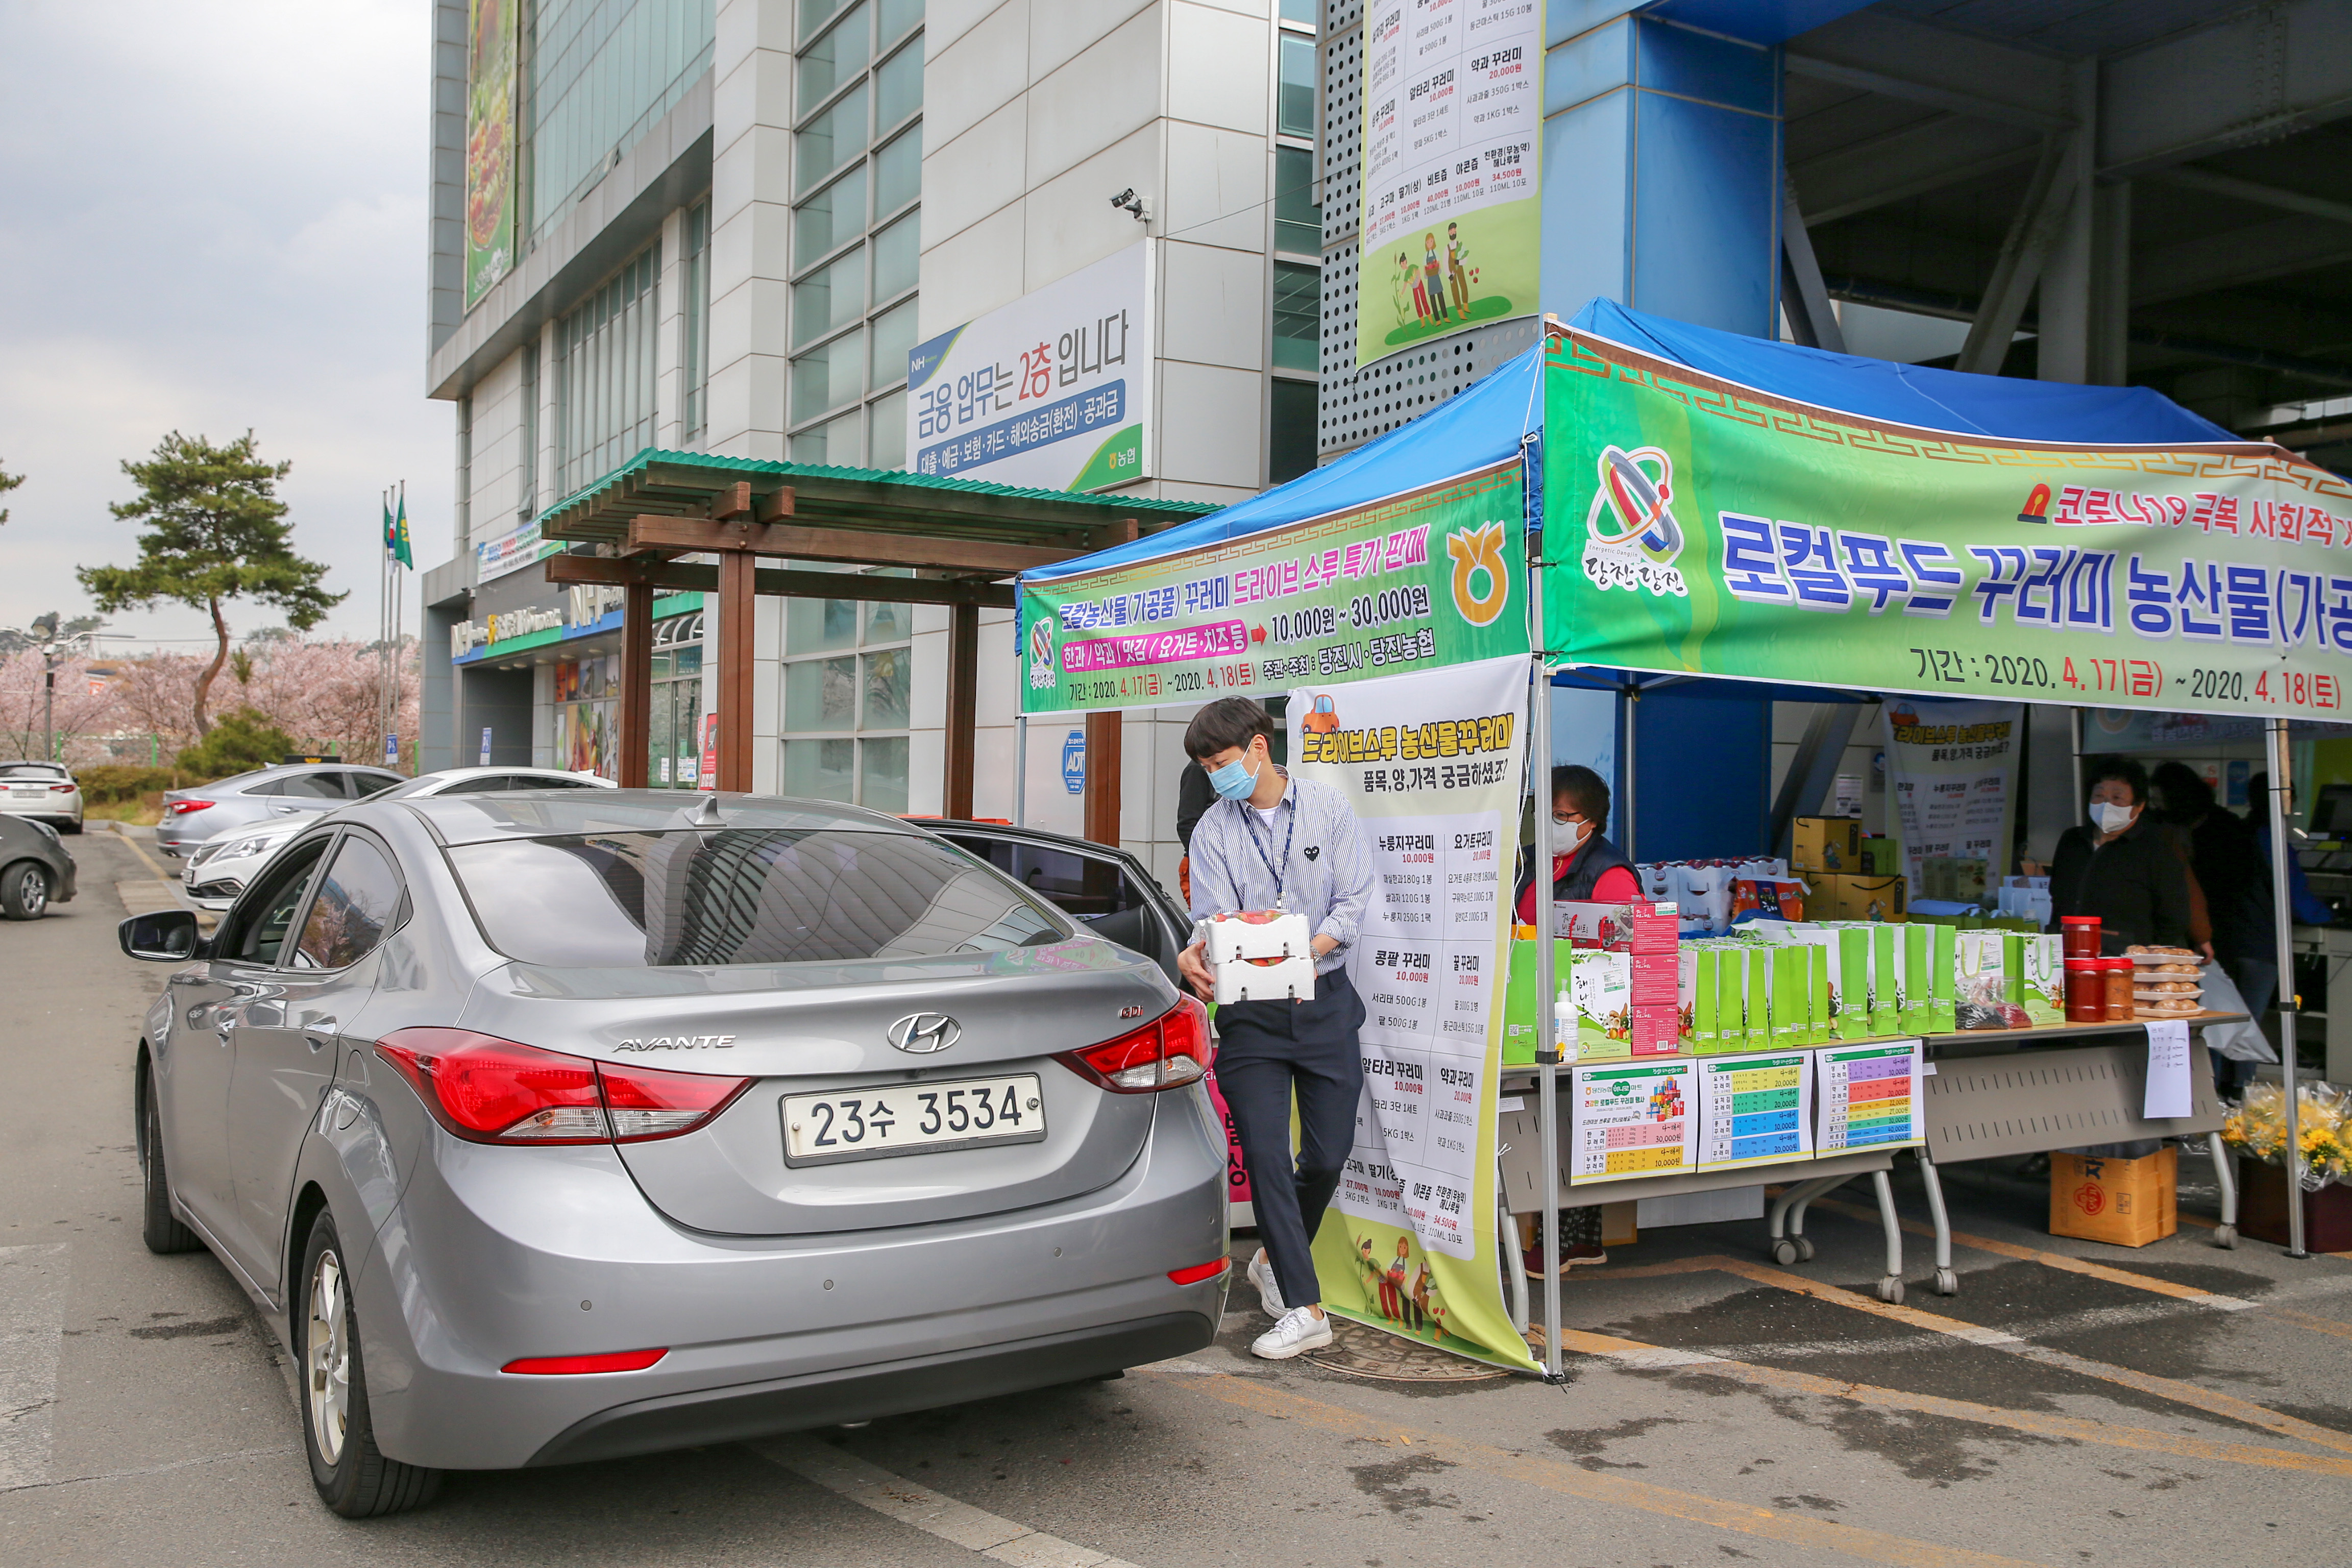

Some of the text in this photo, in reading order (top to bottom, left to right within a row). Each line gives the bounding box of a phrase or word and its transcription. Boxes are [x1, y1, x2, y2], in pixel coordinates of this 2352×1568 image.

[1471, 46, 1522, 72] 약과 꾸러미
[1489, 63, 1522, 79] 20,000원
[1409, 68, 1454, 101] 알타리 꾸러미
[1466, 80, 1529, 104] 사과과줄 350G 1박스
[1429, 85, 1454, 102] 10,000원
[1474, 105, 1520, 124] 약과 1KG 1박스
[1484, 142, 1531, 160] 친환경(무농약)
[1455, 158, 1479, 175] 야콘즙
[1493, 154, 1520, 168] 해나루쌀
[1427, 168, 1447, 186] 비트즙
[1492, 168, 1522, 181] 34,500원
[1398, 179, 1422, 199] 딸기(상)
[1455, 178, 1480, 193] 10,000원
[1490, 178, 1527, 193] 110ML 10포
[1427, 189, 1449, 204] 40,000원
[1400, 200, 1420, 214] 10,000원
[912, 356, 925, 373] NH
[918, 309, 1129, 440] 금융 업무는 2층 입니다
[1118, 447, 1136, 468] 농협
[2053, 486, 2187, 526] 코로나19
[2193, 493, 2240, 534] 극복
[2248, 500, 2334, 546] 사회적
[1588, 544, 1638, 558] Energetic Dangjin
[1060, 524, 1430, 632] 로컬농산물(가공품) 꾸러미 드라이브 스루 특가 판매
[1722, 516, 1962, 611] 로컬푸드
[1969, 547, 2117, 628] 꾸러미
[570, 584, 604, 629] NH
[1272, 586, 1430, 644] 10,000원 30,000원
[451, 620, 473, 658] NH
[1064, 645, 1085, 669] 한과
[1094, 641, 1116, 665] 약과
[1123, 639, 1148, 662] 맛김
[1069, 683, 1086, 702] 기간
[1093, 680, 1118, 699] 2020.
[1120, 678, 1130, 697] 4.
[1132, 673, 1162, 696] 17(금)
[1207, 668, 1218, 689] 4.
[1222, 662, 1256, 688] 18(토)
[1910, 648, 1965, 682] 기간
[1984, 654, 2056, 689] 2020.
[2063, 656, 2086, 691] 4.
[2089, 658, 2164, 698] 17(금)
[2254, 670, 2276, 703] 4.
[2283, 672, 2341, 710] 18(토)
[1301, 712, 1514, 764] 드라이브스루 농산물꾸러미
[1067, 751, 1085, 772] ADT
[1441, 758, 1509, 790] 궁금하셨죠?
[1379, 835, 1434, 852] 누룽지꾸러미
[1454, 830, 1493, 850] 요거트꾸러미
[1402, 852, 1434, 864] 10,000원
[1385, 893, 1431, 904] 쌀과자 120G 1봉
[1382, 912, 1431, 923] 누룽지 250G 1팩
[1375, 950, 1430, 969] 콩팥 꾸러미
[1453, 955, 1479, 971] 꿀 꾸러미
[1395, 971, 1429, 983] 10,000원
[1459, 974, 1479, 986] 20,000원
[1372, 993, 1427, 1008] 서리태 500G 1봉
[1119, 1004, 1143, 1019] GDi
[1378, 1016, 1418, 1030] 팥 500G 1봉
[611, 1034, 737, 1052] AVANTE
[1362, 1057, 1423, 1080] 알타리 꾸러미
[1889, 1067, 1908, 1076] 10,000원
[1440, 1067, 1474, 1089] 약과 꾸러미
[1775, 1077, 1797, 1088] 20,000원
[1394, 1081, 1423, 1094] 10,000원
[1888, 1088, 1908, 1097] 20,000원
[1454, 1091, 1472, 1104] 20,000원
[1774, 1098, 1796, 1108] 20,000원
[1890, 1097, 1908, 1107] 22,000원
[811, 1084, 1022, 1147] 23수 3534
[1889, 1106, 1908, 1115] 27,000원
[1775, 1120, 1796, 1131] 10,000원
[1889, 1115, 1908, 1124] 10,000원
[1383, 1128, 1414, 1142] 5KG 1박스
[1662, 1123, 1681, 1132] 다~해서
[1888, 1123, 1908, 1133] 40,000원
[1656, 1133, 1681, 1143] 30,000원
[1779, 1133, 1796, 1142] 다~해서
[1889, 1133, 1908, 1141] 10,000원
[895, 1142, 967, 1156] HYUNDAI FOR LIFE
[1661, 1147, 1680, 1156] 다~해서
[1774, 1143, 1797, 1153] 20,000원
[1655, 1158, 1680, 1167] 10,000원
[1346, 1180, 1369, 1193] 27,000원
[1375, 1187, 1400, 1200] 10,000원
[1413, 1183, 1432, 1200] 야콘즙
[1344, 1191, 1369, 1205] 5KG 1박스
[1433, 1215, 1457, 1231] 34,500원
[1428, 1227, 1463, 1244] 110ML 10포
